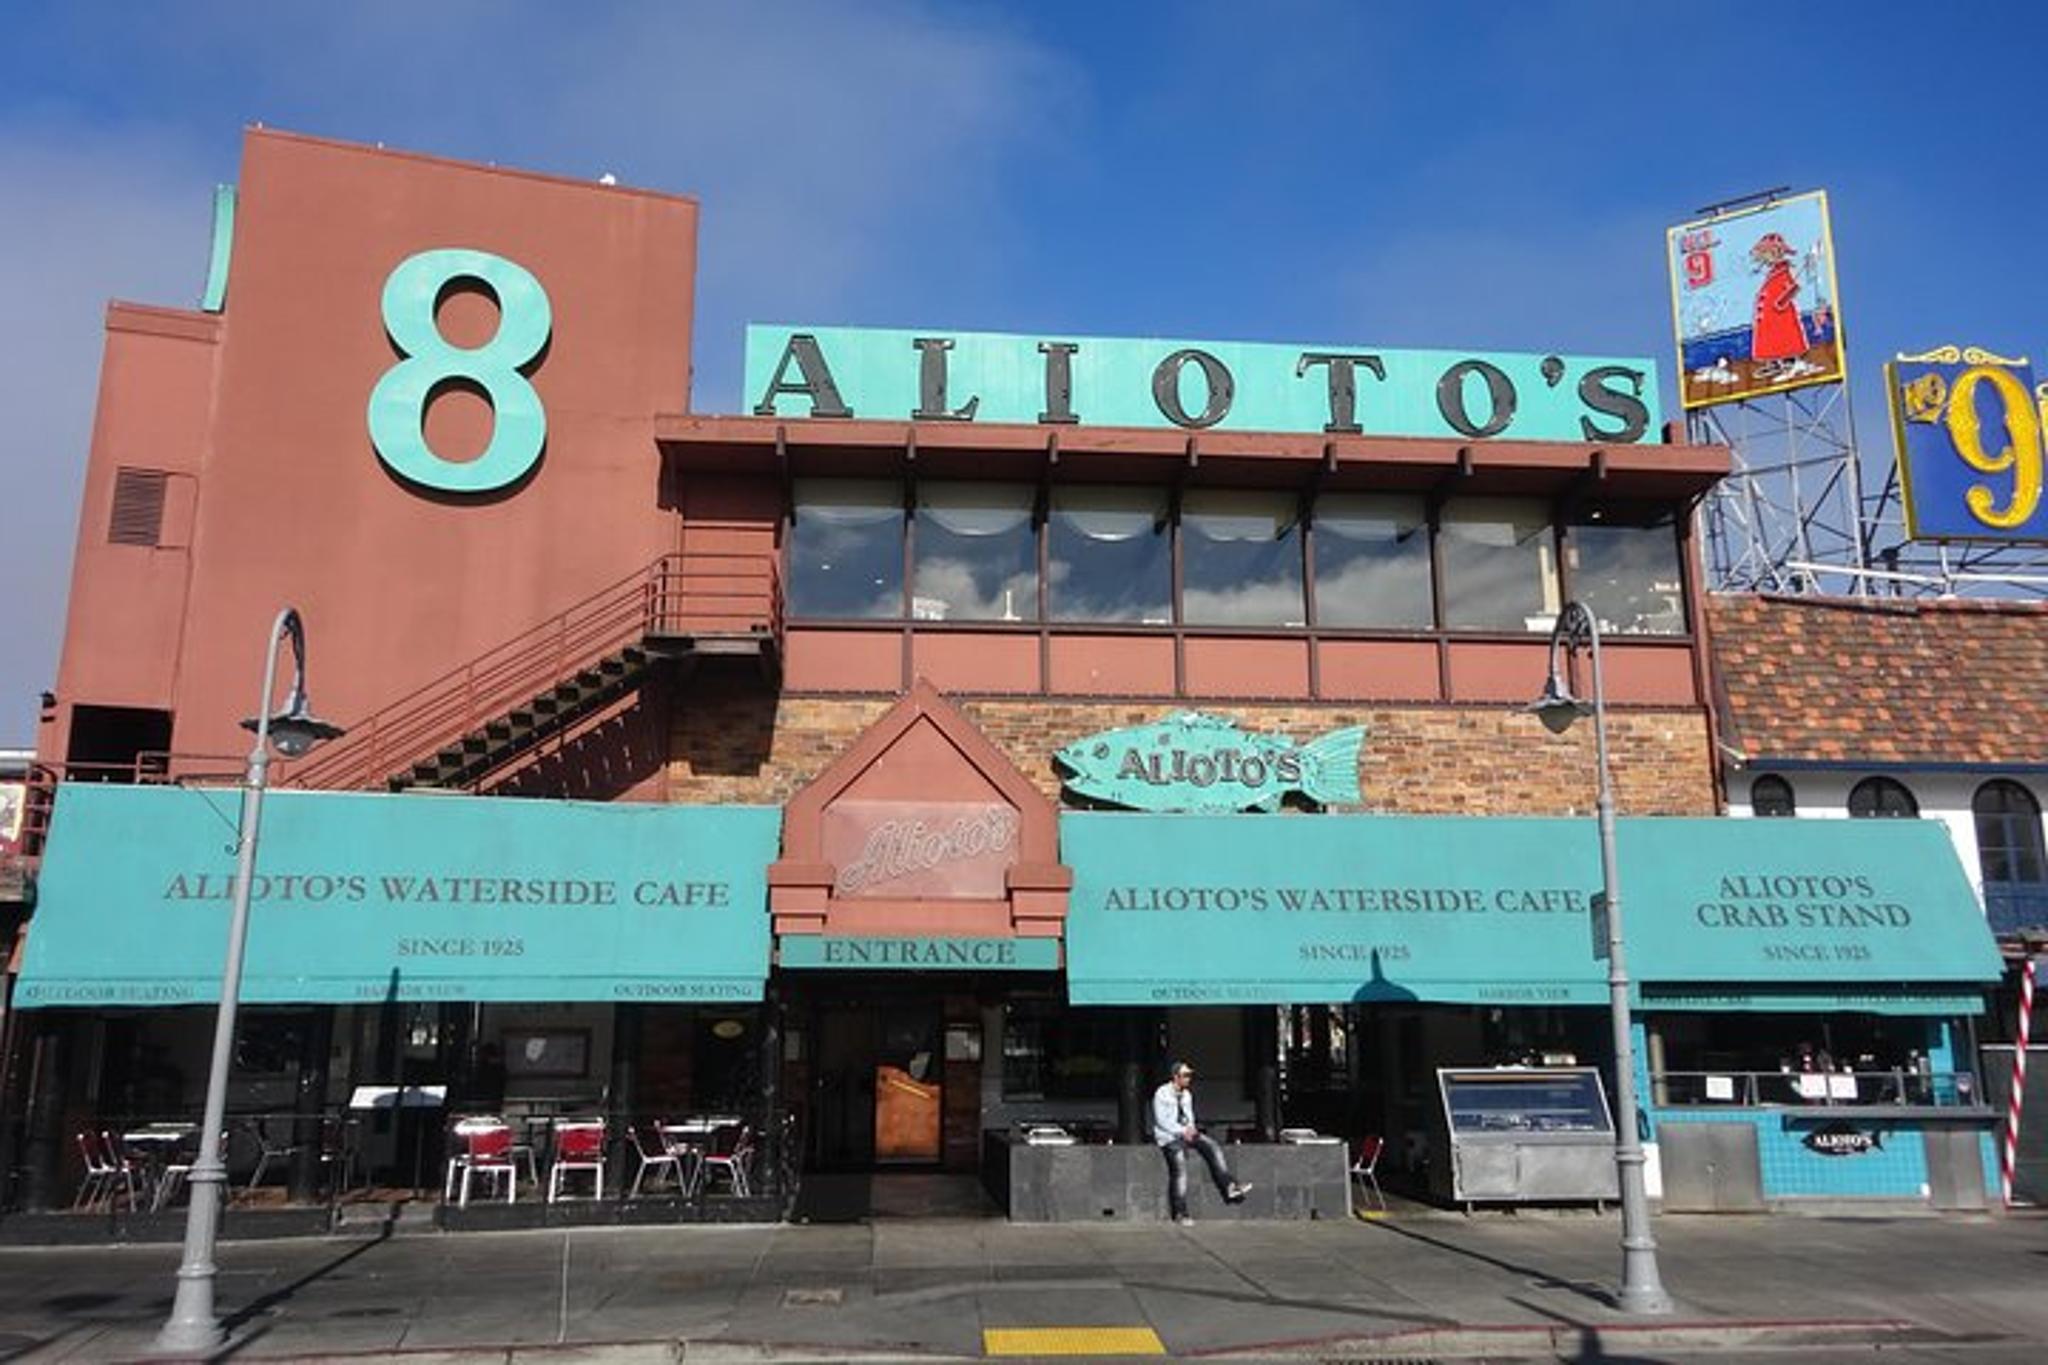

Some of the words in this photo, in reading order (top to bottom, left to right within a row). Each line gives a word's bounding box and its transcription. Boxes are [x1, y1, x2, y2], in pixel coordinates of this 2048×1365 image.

[1685, 252, 1713, 287] 9
[367, 248, 552, 490] 8
[754, 334, 1650, 443] ALIOTO'S
[1947, 366, 2043, 528] 9
[1116, 749, 1302, 788] ALIOTO'S
[837, 804, 1014, 892] Alioto's
[164, 873, 366, 901] ALIOTO'S
[381, 876, 616, 905] WATERSIDE
[633, 880, 730, 907] CAFE
[1104, 888, 1269, 911] ALIOTO'S
[1277, 889, 1486, 912] WATERSIDE
[1496, 889, 1585, 912] CAFE
[1720, 876, 1875, 899] ALIOTO'S
[1697, 903, 1788, 928] CRAB
[1796, 905, 1911, 928] STAND
[398, 938, 475, 956] SINCE
[482, 938, 524, 956] 1925
[824, 941, 1016, 965] ENTRANCE
[1299, 945, 1366, 961] SINCE
[1763, 945, 1832, 961] SINCE
[614, 983, 686, 997] OUTDOOR
